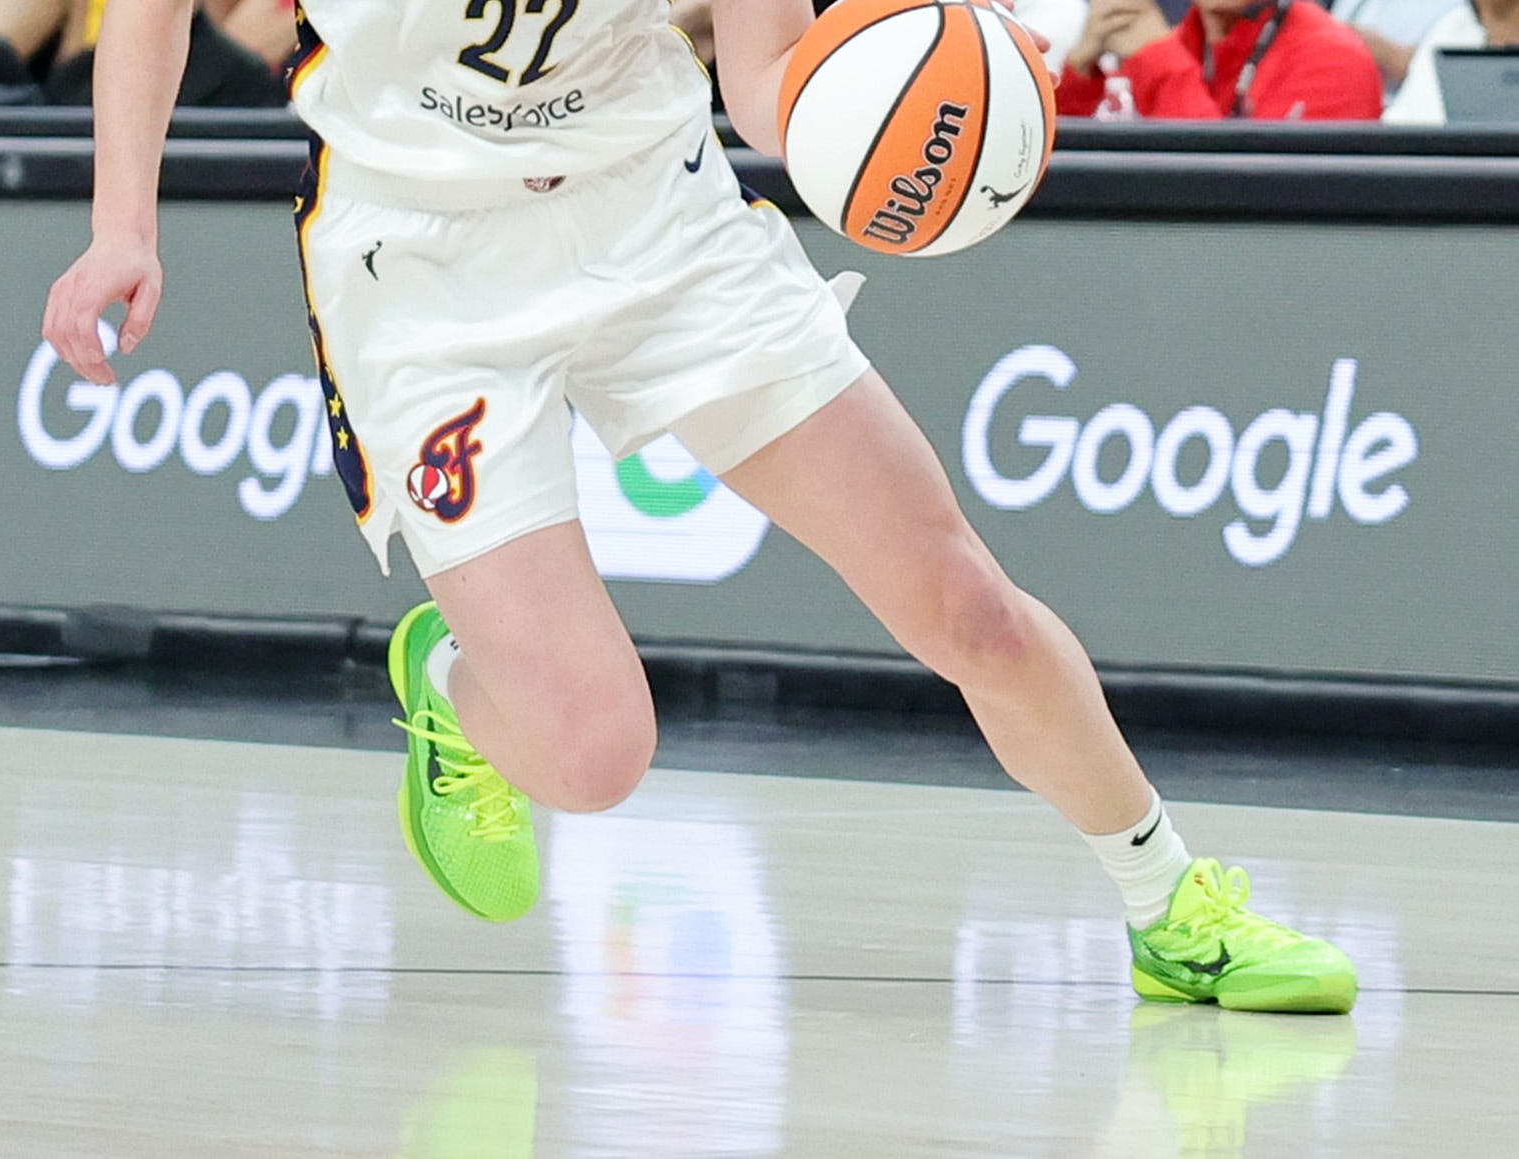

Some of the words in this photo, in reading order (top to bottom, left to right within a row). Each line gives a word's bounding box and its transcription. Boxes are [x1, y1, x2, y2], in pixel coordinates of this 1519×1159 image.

[419, 86, 585, 132] salesforce
[862, 101, 970, 245] Wilson
[18, 318, 331, 521] Goog
[961, 344, 1419, 568] Google
